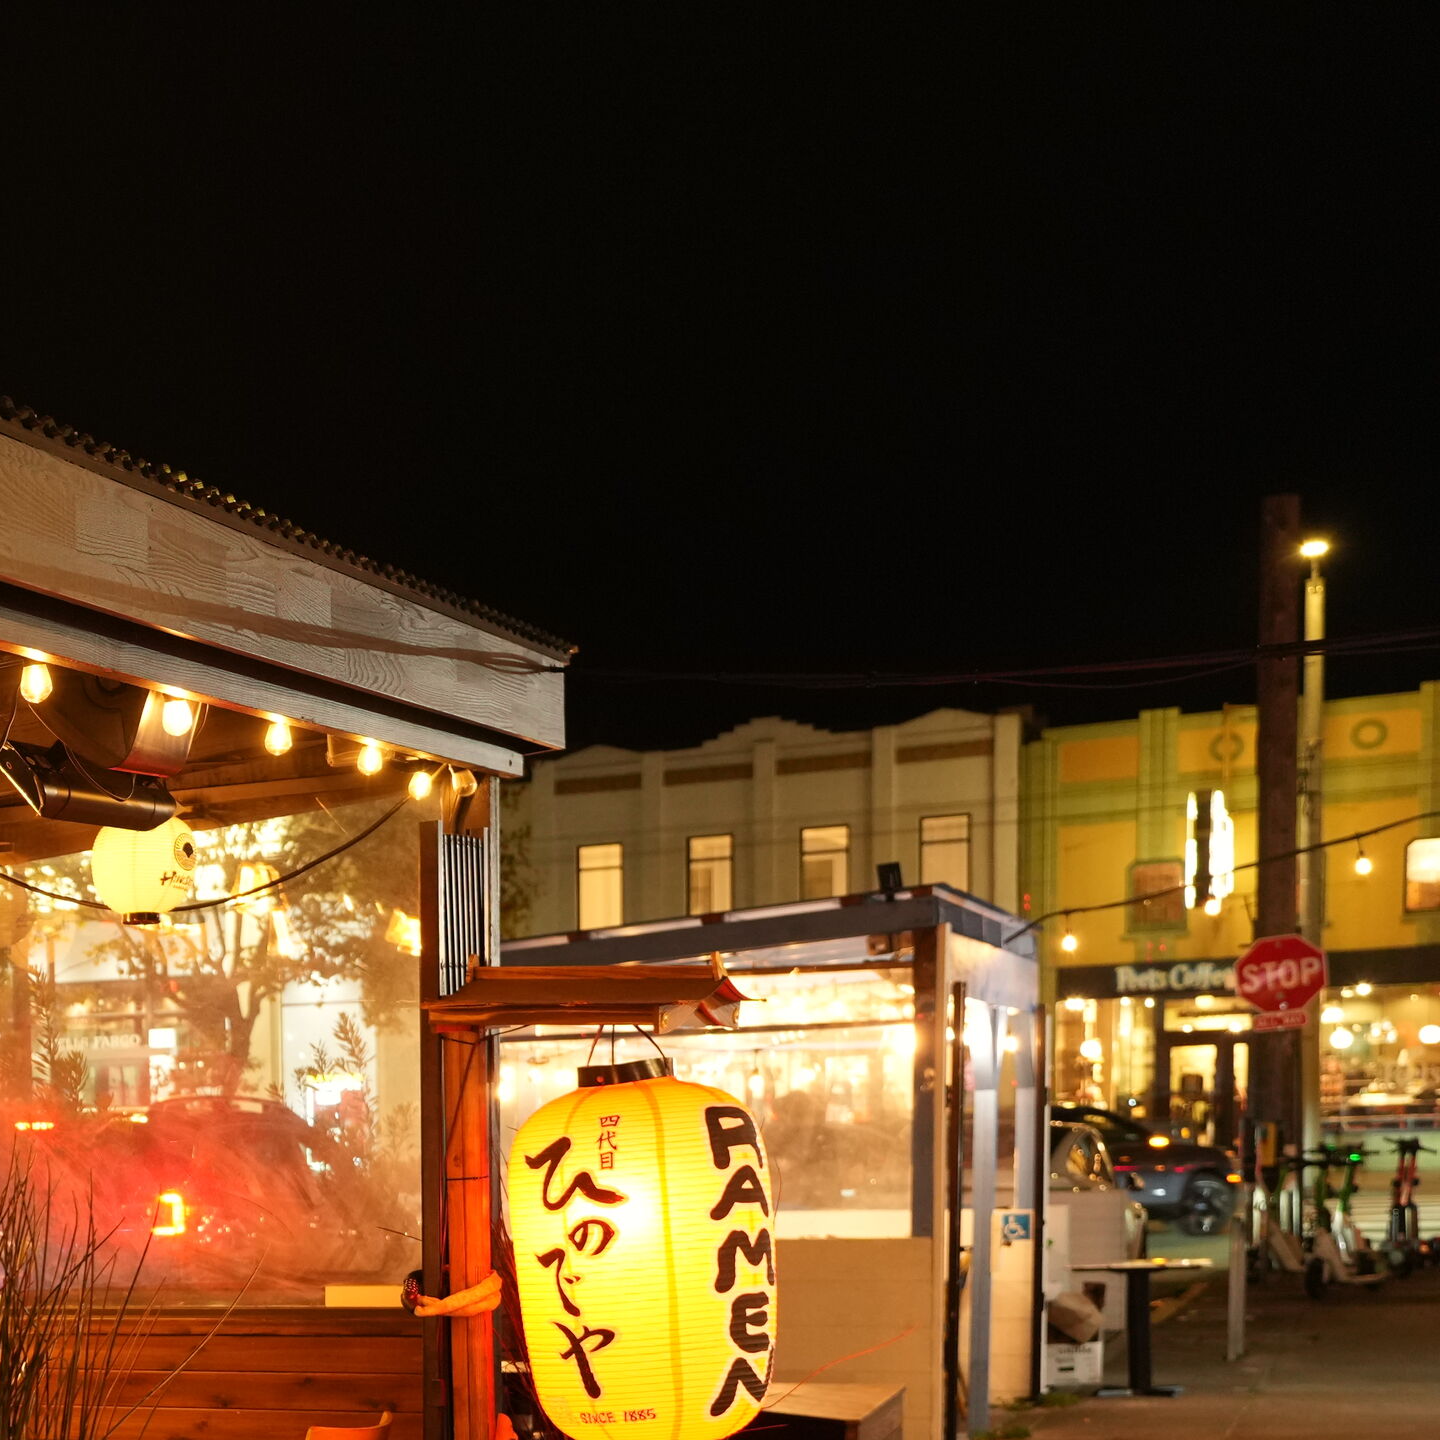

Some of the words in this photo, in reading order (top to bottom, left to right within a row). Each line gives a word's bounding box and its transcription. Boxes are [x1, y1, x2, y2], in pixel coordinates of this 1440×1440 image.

[1241, 957, 1321, 994] STOP
[1259, 1016, 1278, 1025] ALL
[1283, 1013, 1301, 1024] WAY
[595, 1114, 620, 1170] 四代目
[525, 1136, 628, 1399] ひのでや
[705, 1106, 776, 1417] RAMEN
[580, 1411, 616, 1425] SINCE
[623, 1409, 656, 1423] 1885
